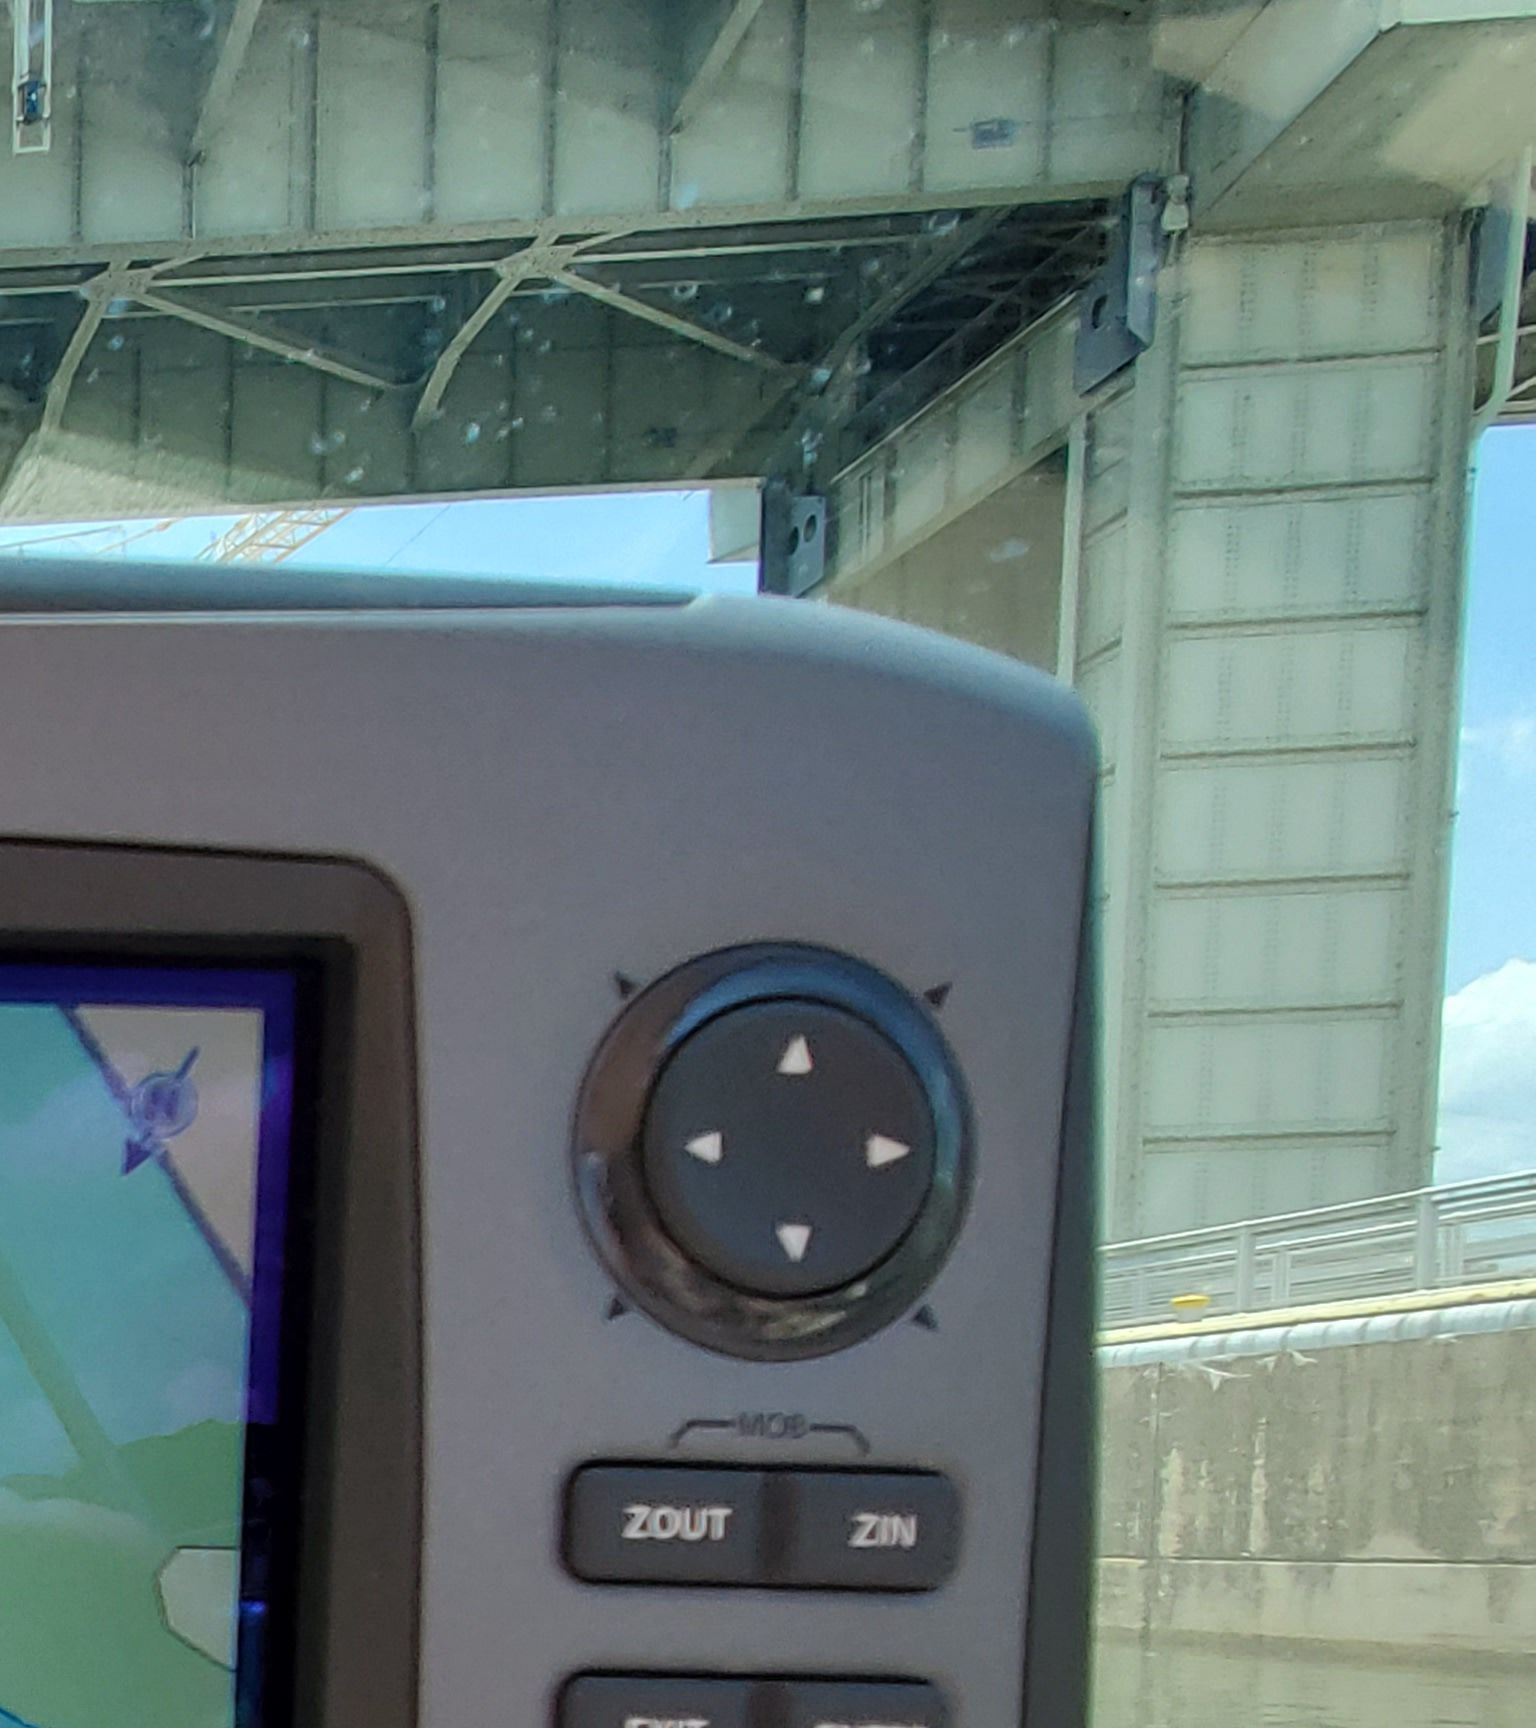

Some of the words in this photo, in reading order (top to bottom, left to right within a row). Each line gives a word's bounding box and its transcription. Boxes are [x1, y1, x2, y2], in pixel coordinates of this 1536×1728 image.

[738, 1414, 808, 1440] MOB
[623, 1506, 730, 1540] ZOUT
[849, 1513, 918, 1548] ZIN
